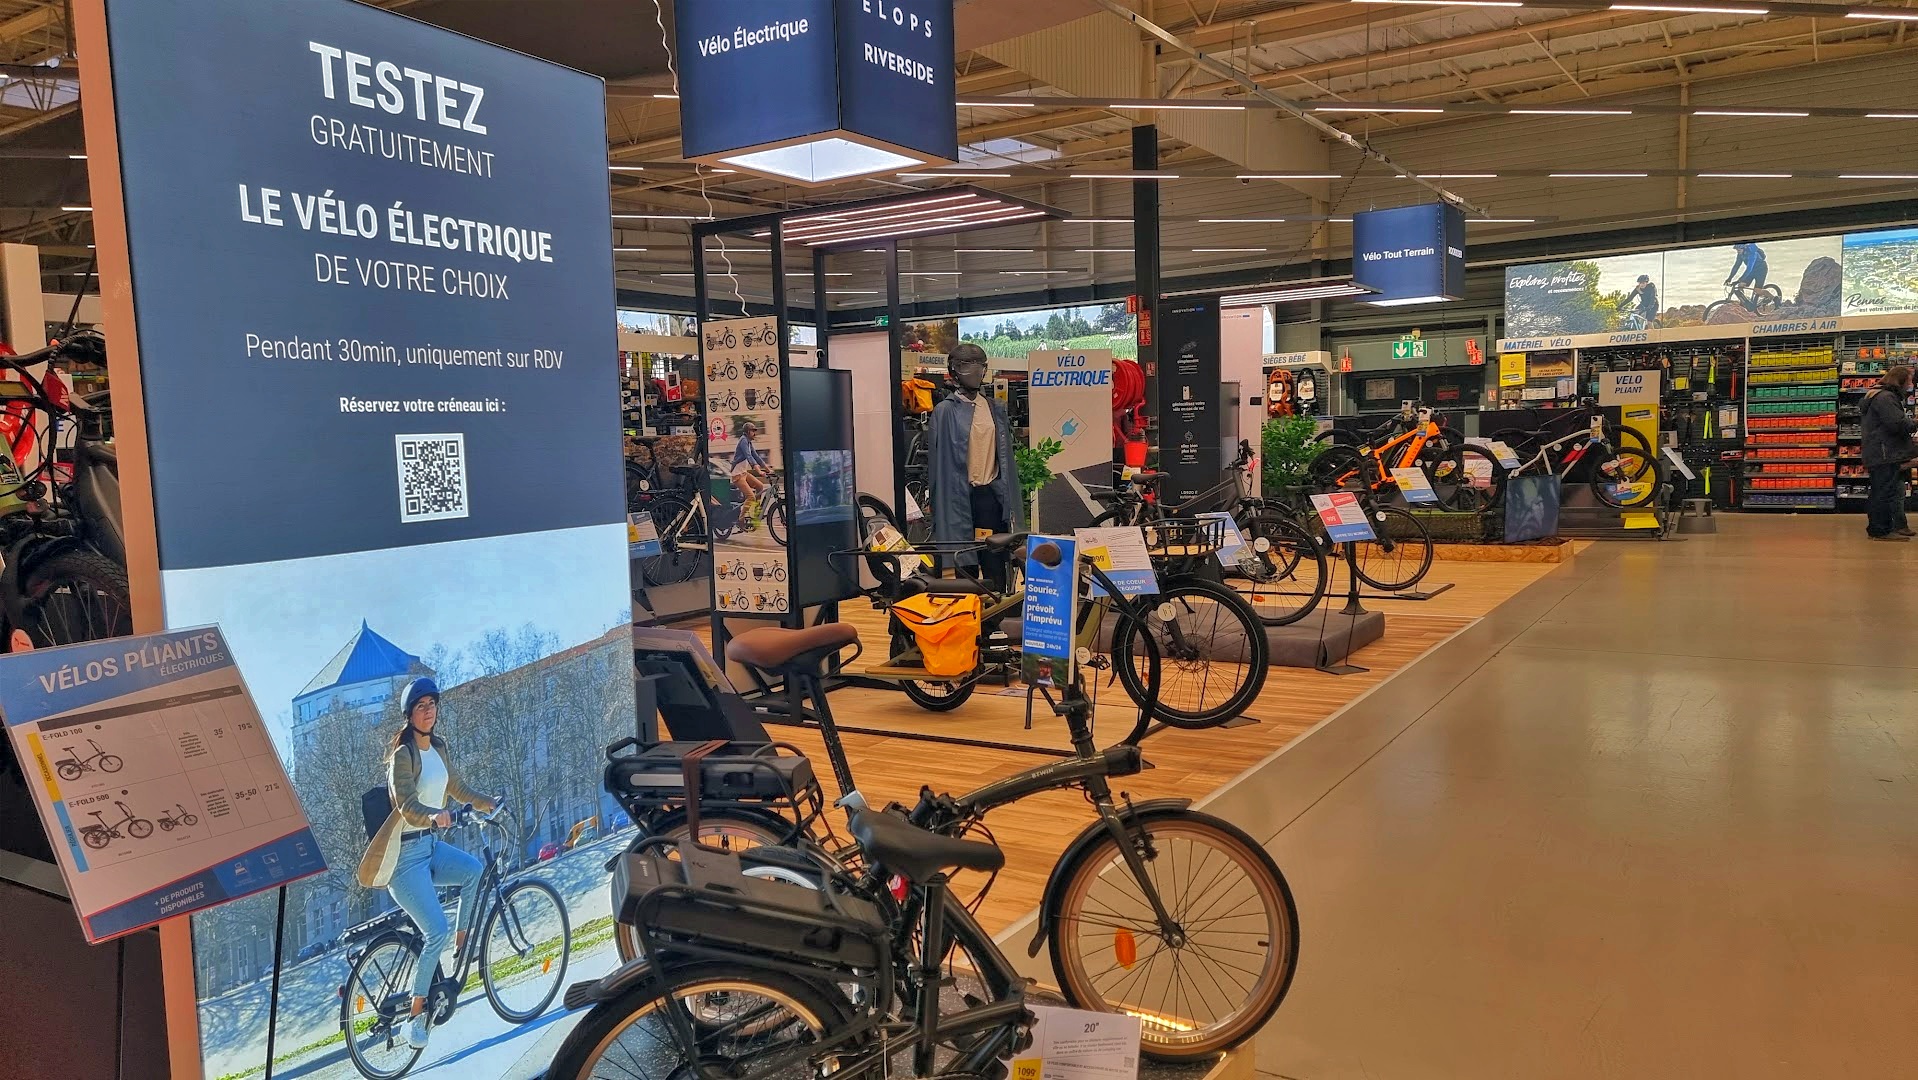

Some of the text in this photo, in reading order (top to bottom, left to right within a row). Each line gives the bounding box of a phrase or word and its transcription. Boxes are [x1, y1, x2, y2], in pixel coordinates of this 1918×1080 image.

[699, 18, 809, 57] Vélo Électrique
[864, 43, 934, 85] RIVERSIDE
[309, 41, 487, 135] TESTEZ
[310, 115, 495, 178] GRATUITEMENT
[239, 184, 553, 263] LE VÉLO ÉLECTRIQUE
[1363, 247, 1435, 261] Vélo Tout Terrain
[315, 253, 509, 300] DE VOTRE CHOIX
[1551, 271, 1587, 286] profitez
[1845, 293, 1886, 309] Rennes
[1753, 320, 1837, 334] CHAMBRES À AIR
[1504, 338, 1571, 350] MATÉRIEL VÉLO
[1609, 333, 1647, 343] POMPES
[245, 334, 563, 370] Pendant 30min, uniquement sur RDV
[1263, 353, 1306, 365] SIÈGES BÉBÉ
[1057, 354, 1085, 367] VÉLO
[1031, 368, 1110, 387] ÉLECTRIQUE
[1616, 375, 1643, 385] VELO
[1615, 386, 1643, 394] PLIANT
[340, 397, 400, 413] Réservez
[403, 399, 434, 412] votre
[437, 398, 483, 412] créneau
[485, 398, 499, 412] ici
[1028, 584, 1059, 597] Souriez,
[1026, 604, 1054, 614] prévoit
[1026, 612, 1062, 626] l'imprévu
[39, 632, 218, 694] VÉLOS PLIANTS
[160, 652, 224, 677] ÉLECTRIQUES
[42, 730, 69, 741] E-FOLD
[213, 728, 223, 736] 35
[68, 794, 110, 808] E-FOLD 500
[235, 788, 257, 800] 35-50
[160, 894, 171, 905] DE
[171, 882, 204, 900] PRODUITS
[161, 892, 205, 915] DISPONIBLES
